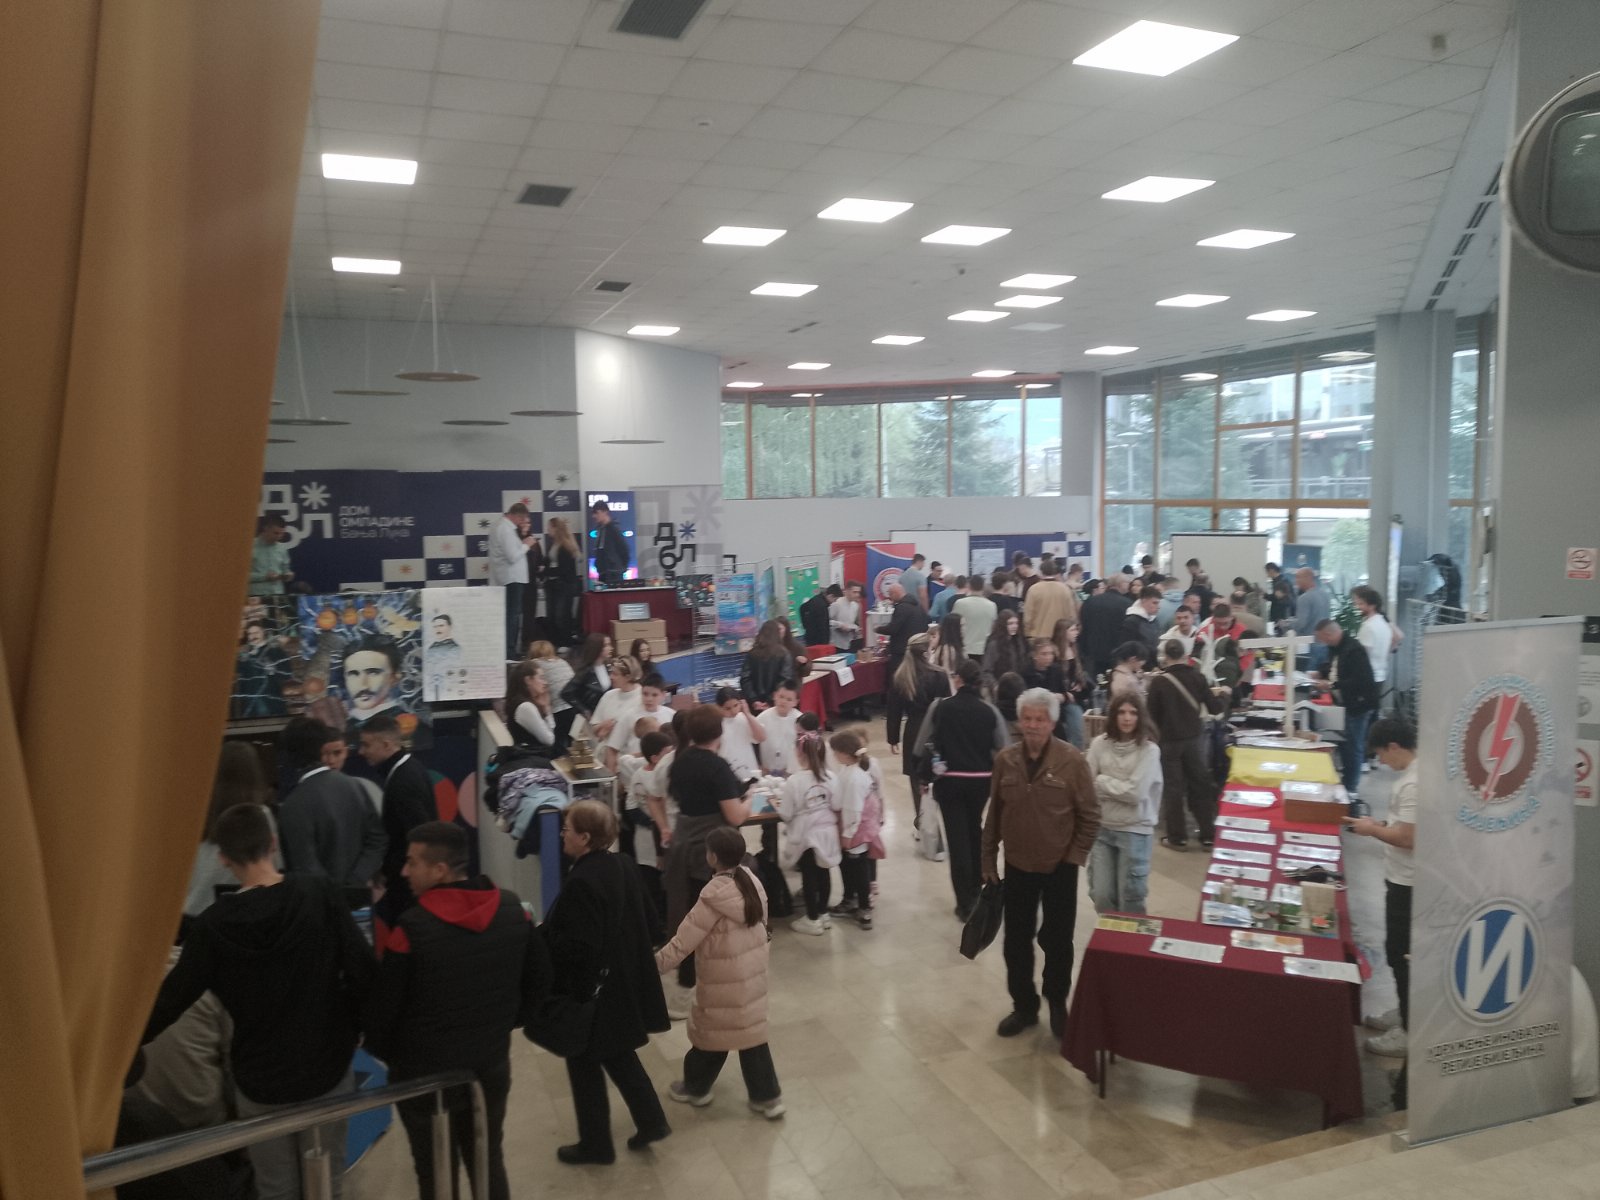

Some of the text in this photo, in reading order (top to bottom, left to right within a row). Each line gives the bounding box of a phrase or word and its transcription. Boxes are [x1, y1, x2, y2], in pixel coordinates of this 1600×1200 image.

[339, 506, 371, 517] ДОМ
[339, 516, 415, 528] ОМЛАДИНЕ
[1493, 1021, 1560, 1045] ИНОВАТОРА
